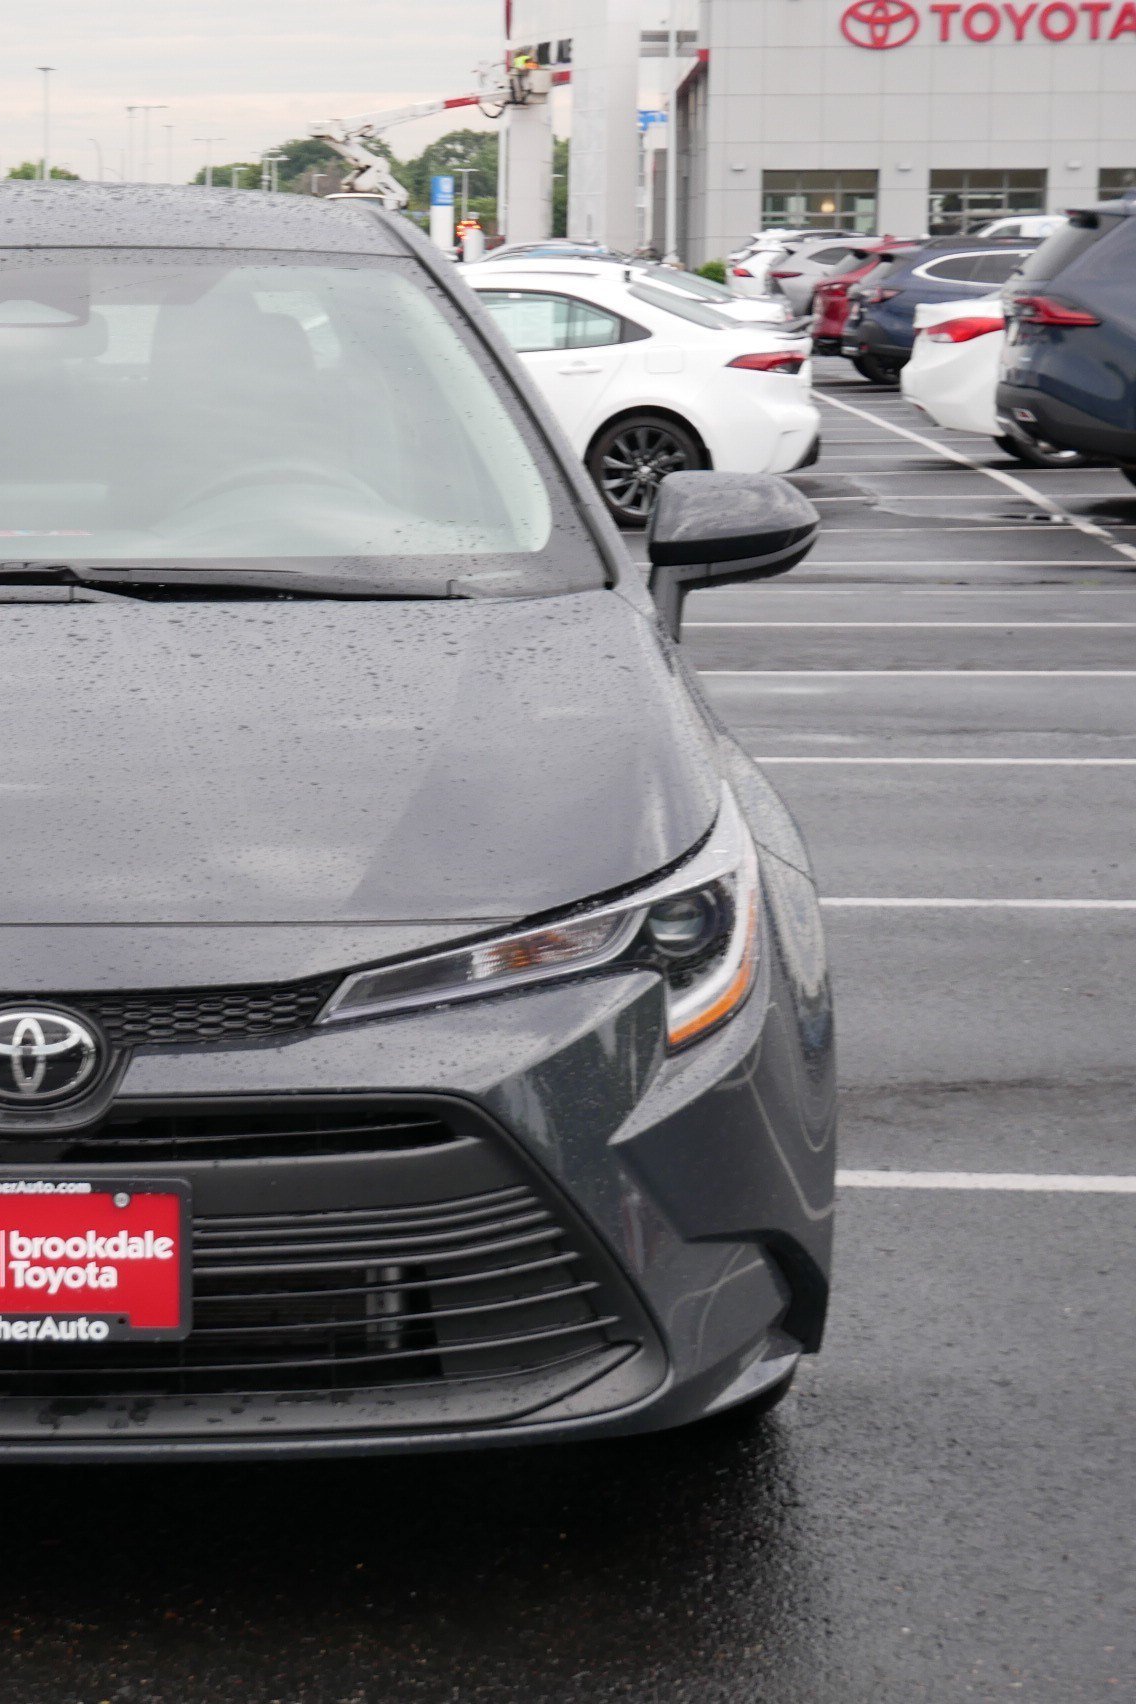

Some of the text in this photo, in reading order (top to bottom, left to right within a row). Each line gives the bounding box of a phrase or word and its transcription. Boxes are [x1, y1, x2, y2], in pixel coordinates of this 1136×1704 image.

[929, 2, 1136, 43] TOYOTA
[9, 1230, 174, 1260] brookdale
[8, 1260, 118, 1294] Toyota
